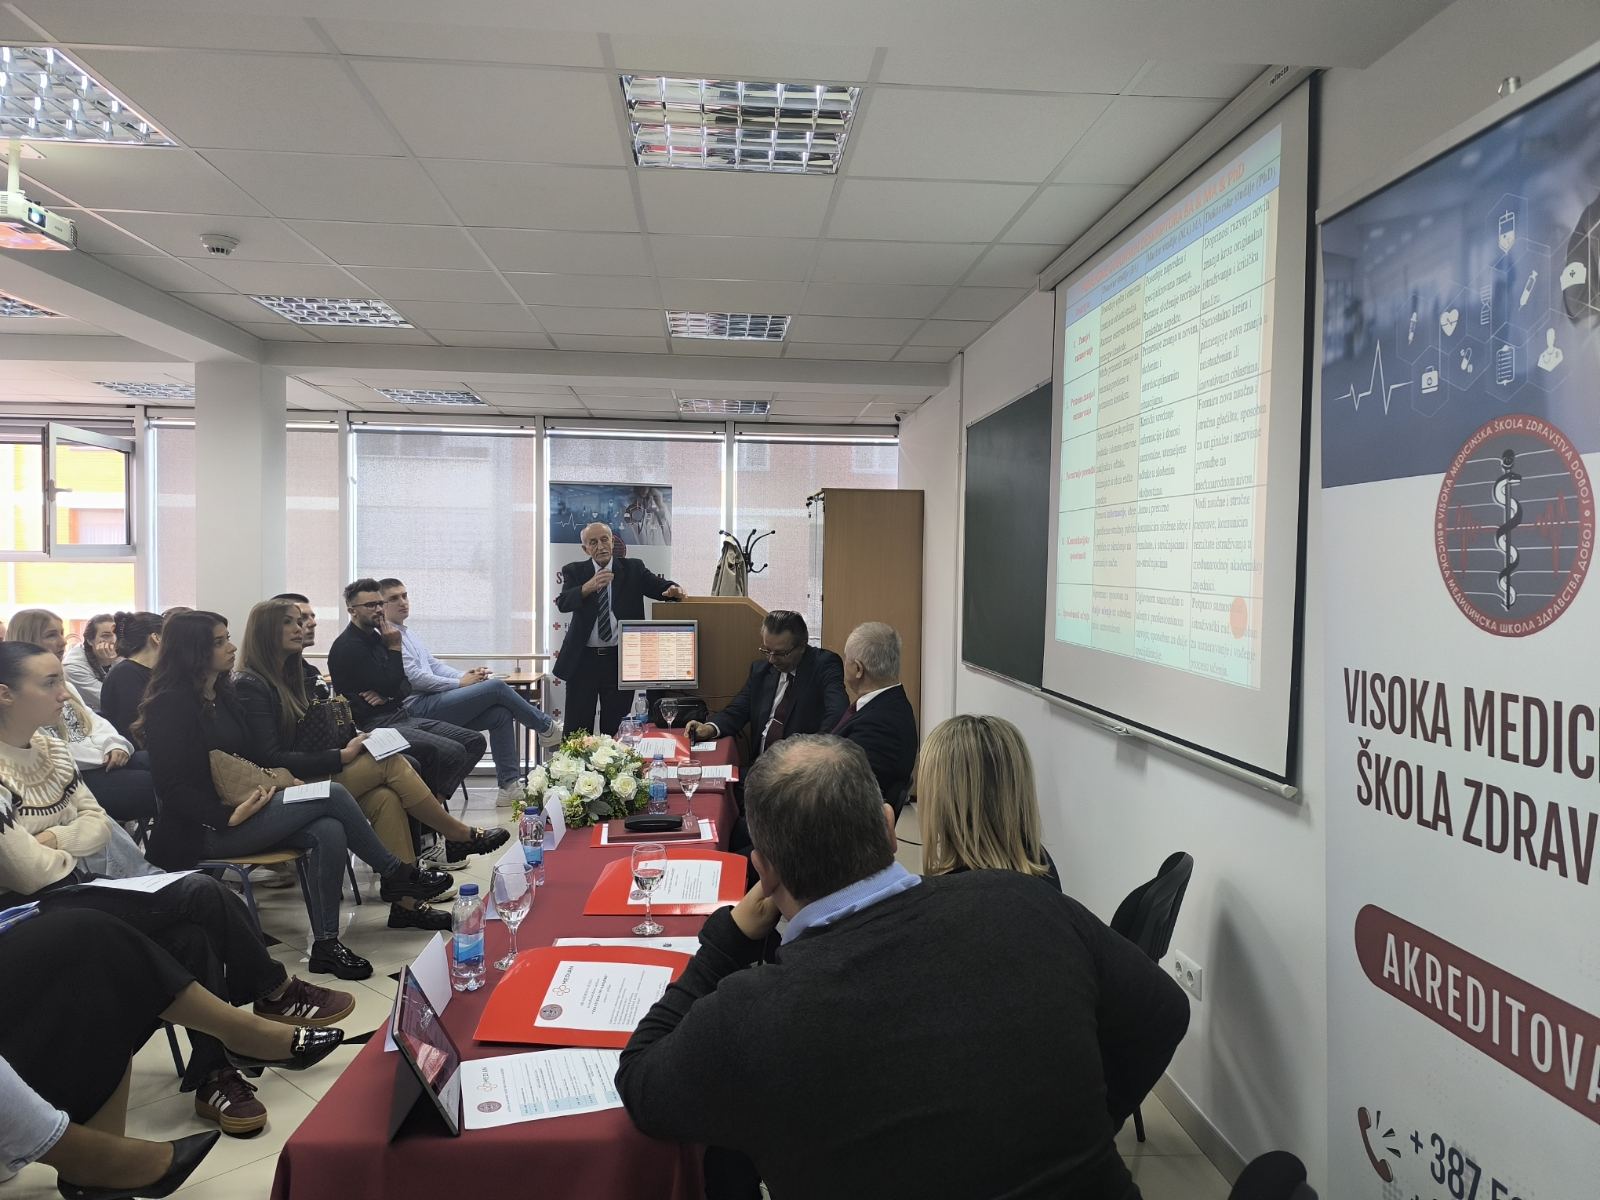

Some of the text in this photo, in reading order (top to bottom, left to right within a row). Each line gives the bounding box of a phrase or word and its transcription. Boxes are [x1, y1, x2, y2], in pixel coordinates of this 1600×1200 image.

[1438, 479, 1452, 519] VISOKA
[1450, 426, 1493, 477] MEDICINSKA
[1494, 418, 1523, 432] ŠKOLA
[1526, 419, 1574, 462] ZDRAVSTVA
[1500, 620, 1536, 634] ШКОЛА
[1343, 667, 1600, 784] VISOKA MEDIC
[1356, 736, 1599, 886] ŠKOLA ZDRAV
